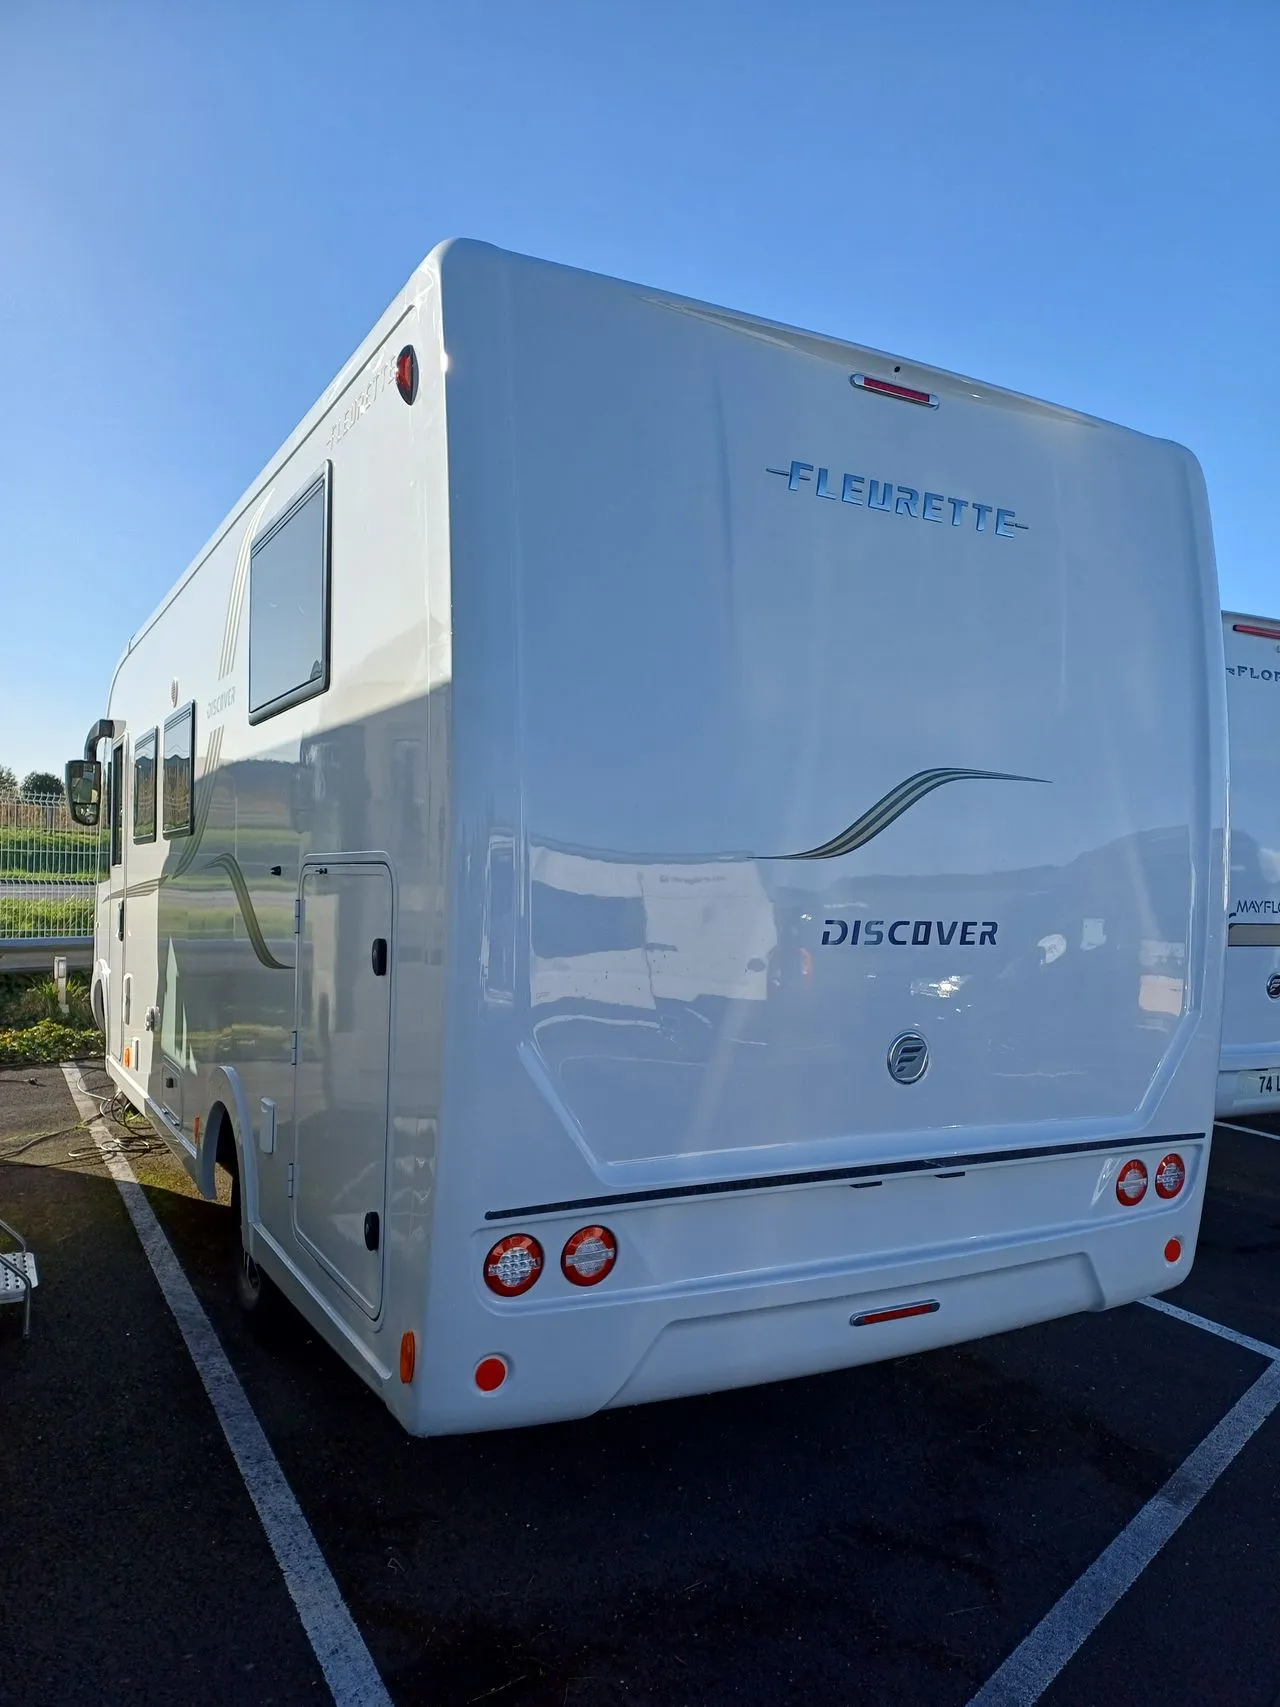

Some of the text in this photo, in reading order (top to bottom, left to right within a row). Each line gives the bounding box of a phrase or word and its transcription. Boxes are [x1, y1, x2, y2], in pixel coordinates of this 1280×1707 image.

[787, 460, 1017, 538] FLEURETTE
[1236, 899, 1280, 914] MAYFL
[821, 919, 998, 946] DISCOVER
[1259, 1075, 1272, 1094] 74
